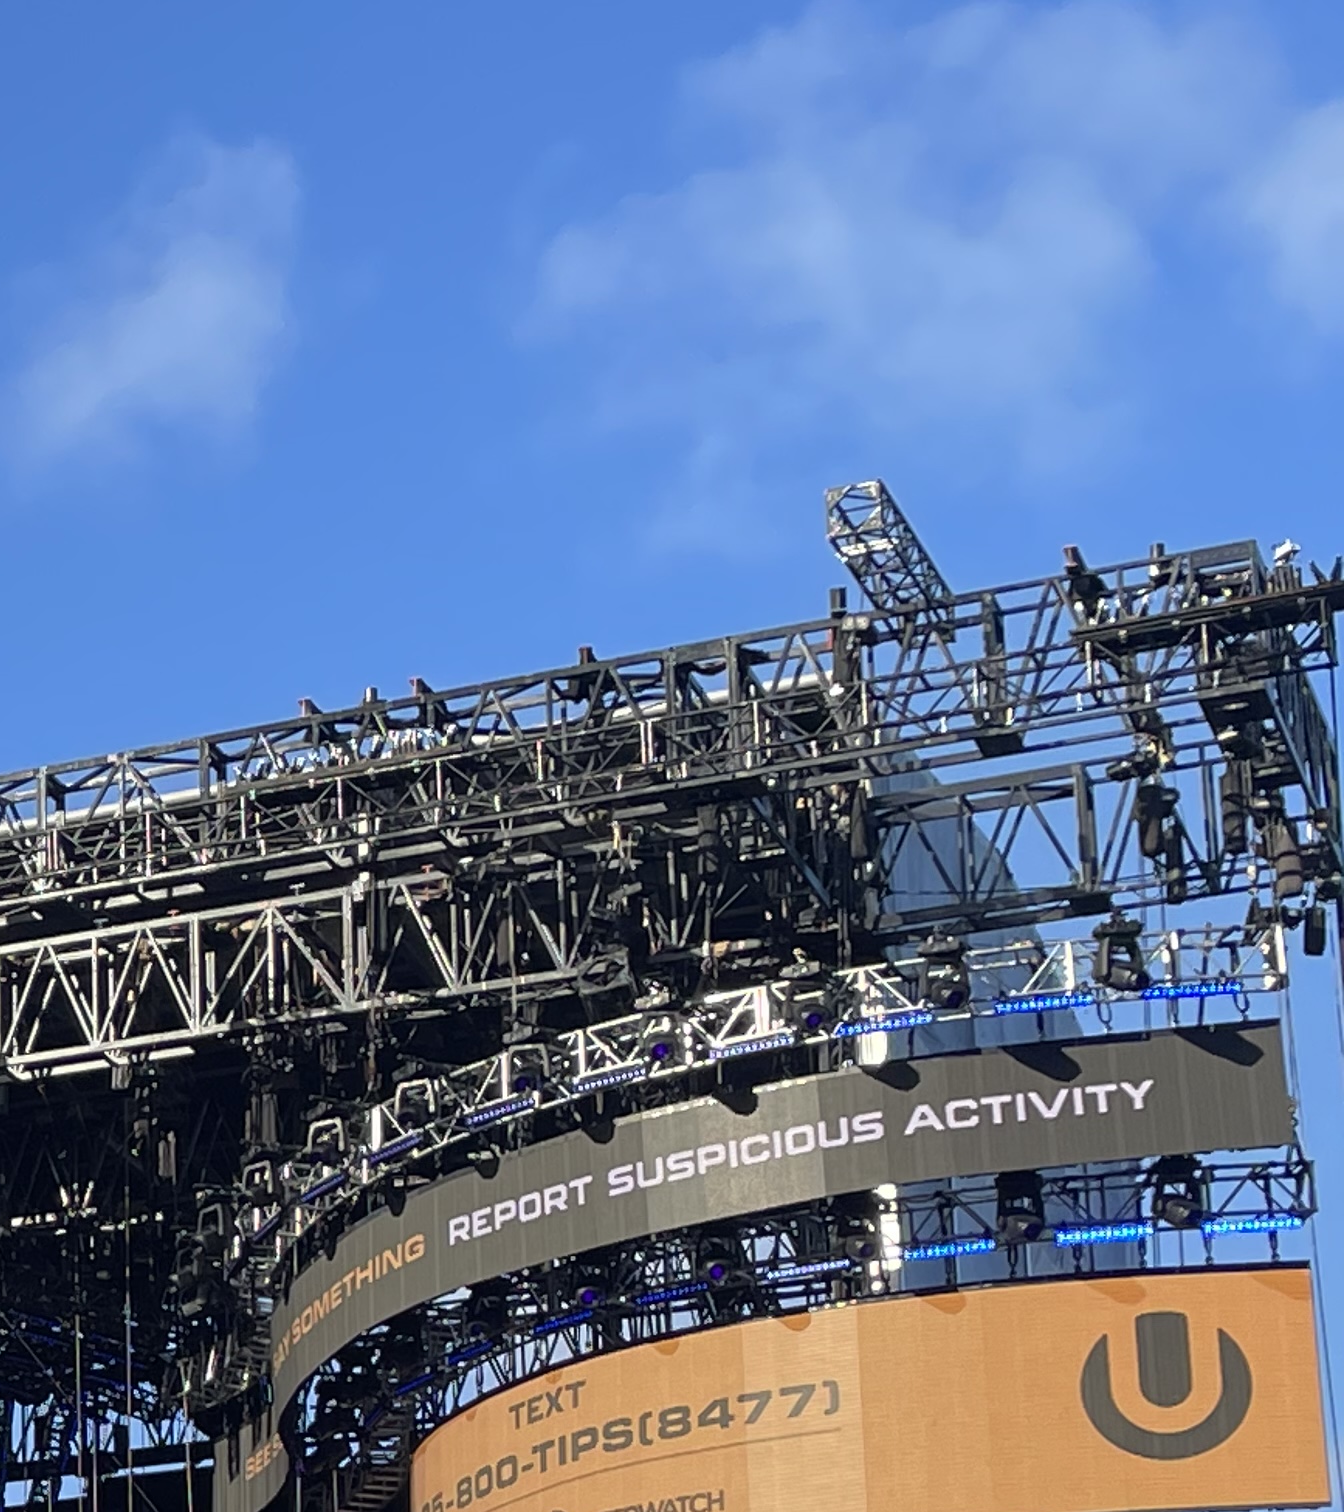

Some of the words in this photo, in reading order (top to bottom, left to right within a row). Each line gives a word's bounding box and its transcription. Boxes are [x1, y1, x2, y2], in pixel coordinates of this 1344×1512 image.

[291, 1233, 426, 1344] SOMETHING
[448, 1175, 594, 1248] REPORT
[608, 1110, 886, 1198] SUSPICIOUS
[903, 1078, 1158, 1140] ACTIVITY
[509, 1380, 587, 1431] TEXT
